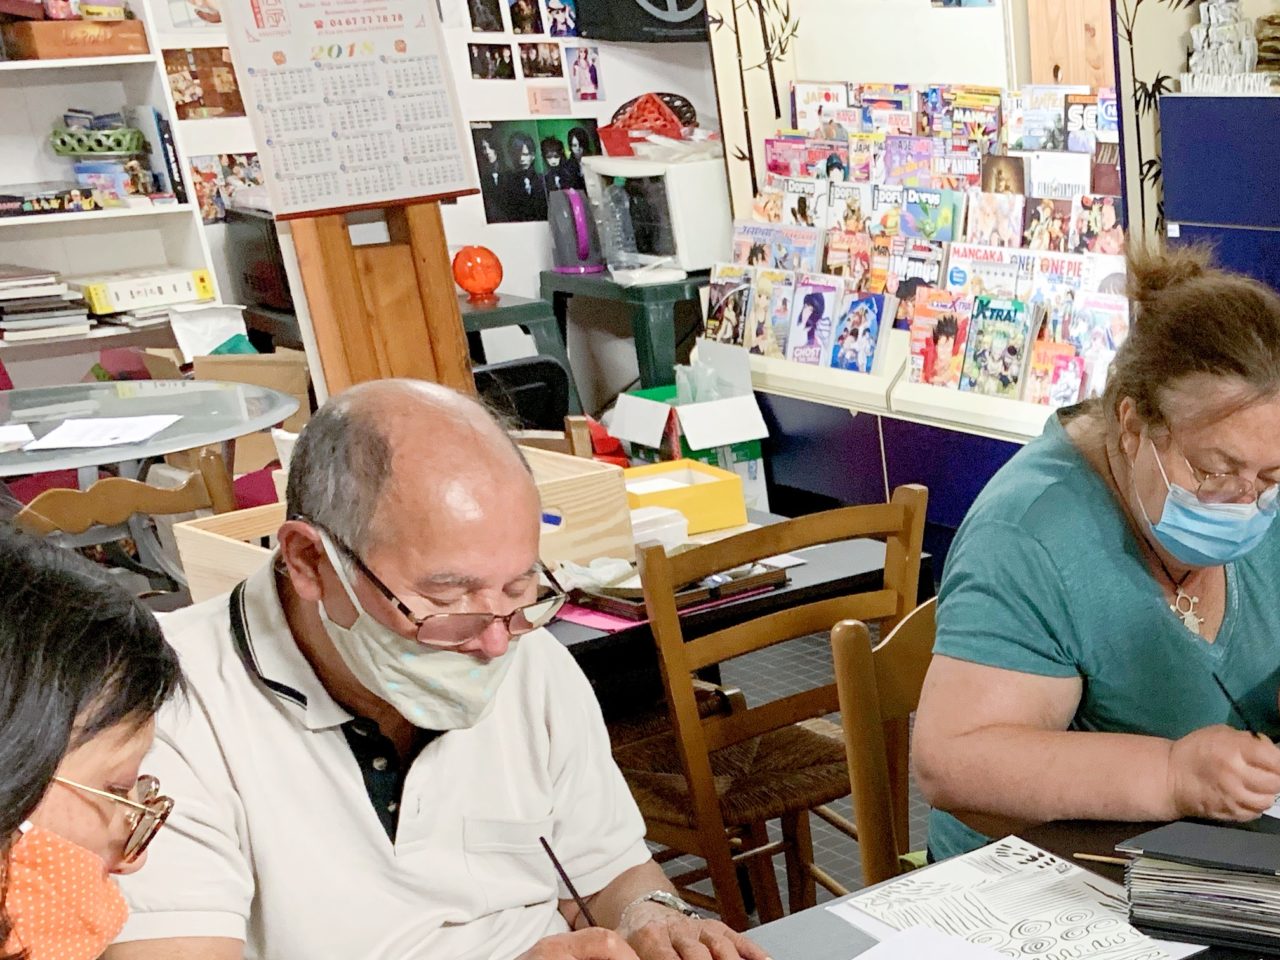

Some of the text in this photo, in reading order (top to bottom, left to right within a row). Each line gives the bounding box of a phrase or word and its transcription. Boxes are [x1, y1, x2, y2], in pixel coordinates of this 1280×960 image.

[803, 91, 839, 104] JAPON
[951, 247, 1004, 263] MANGAKA
[974, 300, 1018, 323] XTRA!
